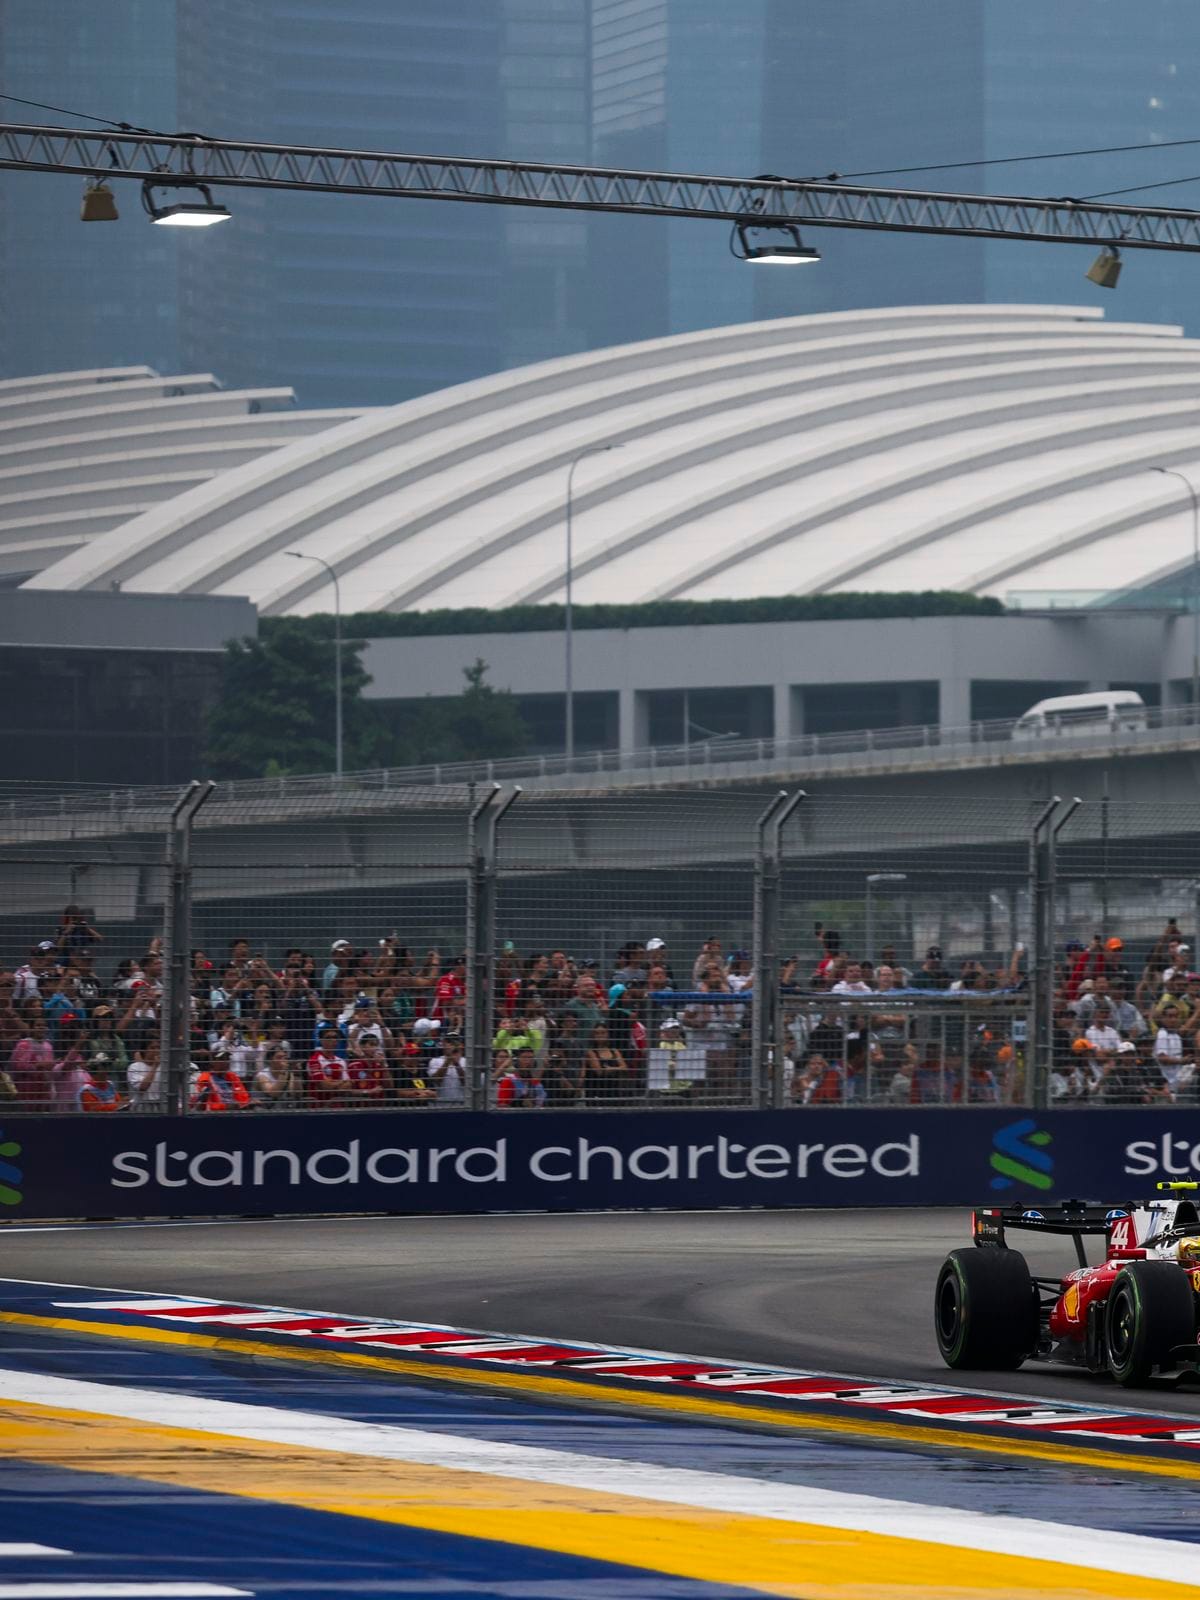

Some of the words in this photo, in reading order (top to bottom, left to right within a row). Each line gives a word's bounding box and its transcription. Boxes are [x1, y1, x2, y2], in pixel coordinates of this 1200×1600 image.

[112, 1139, 506, 1188] standard
[530, 1135, 919, 1181] chartered
[1110, 1221, 1129, 1250] 44
